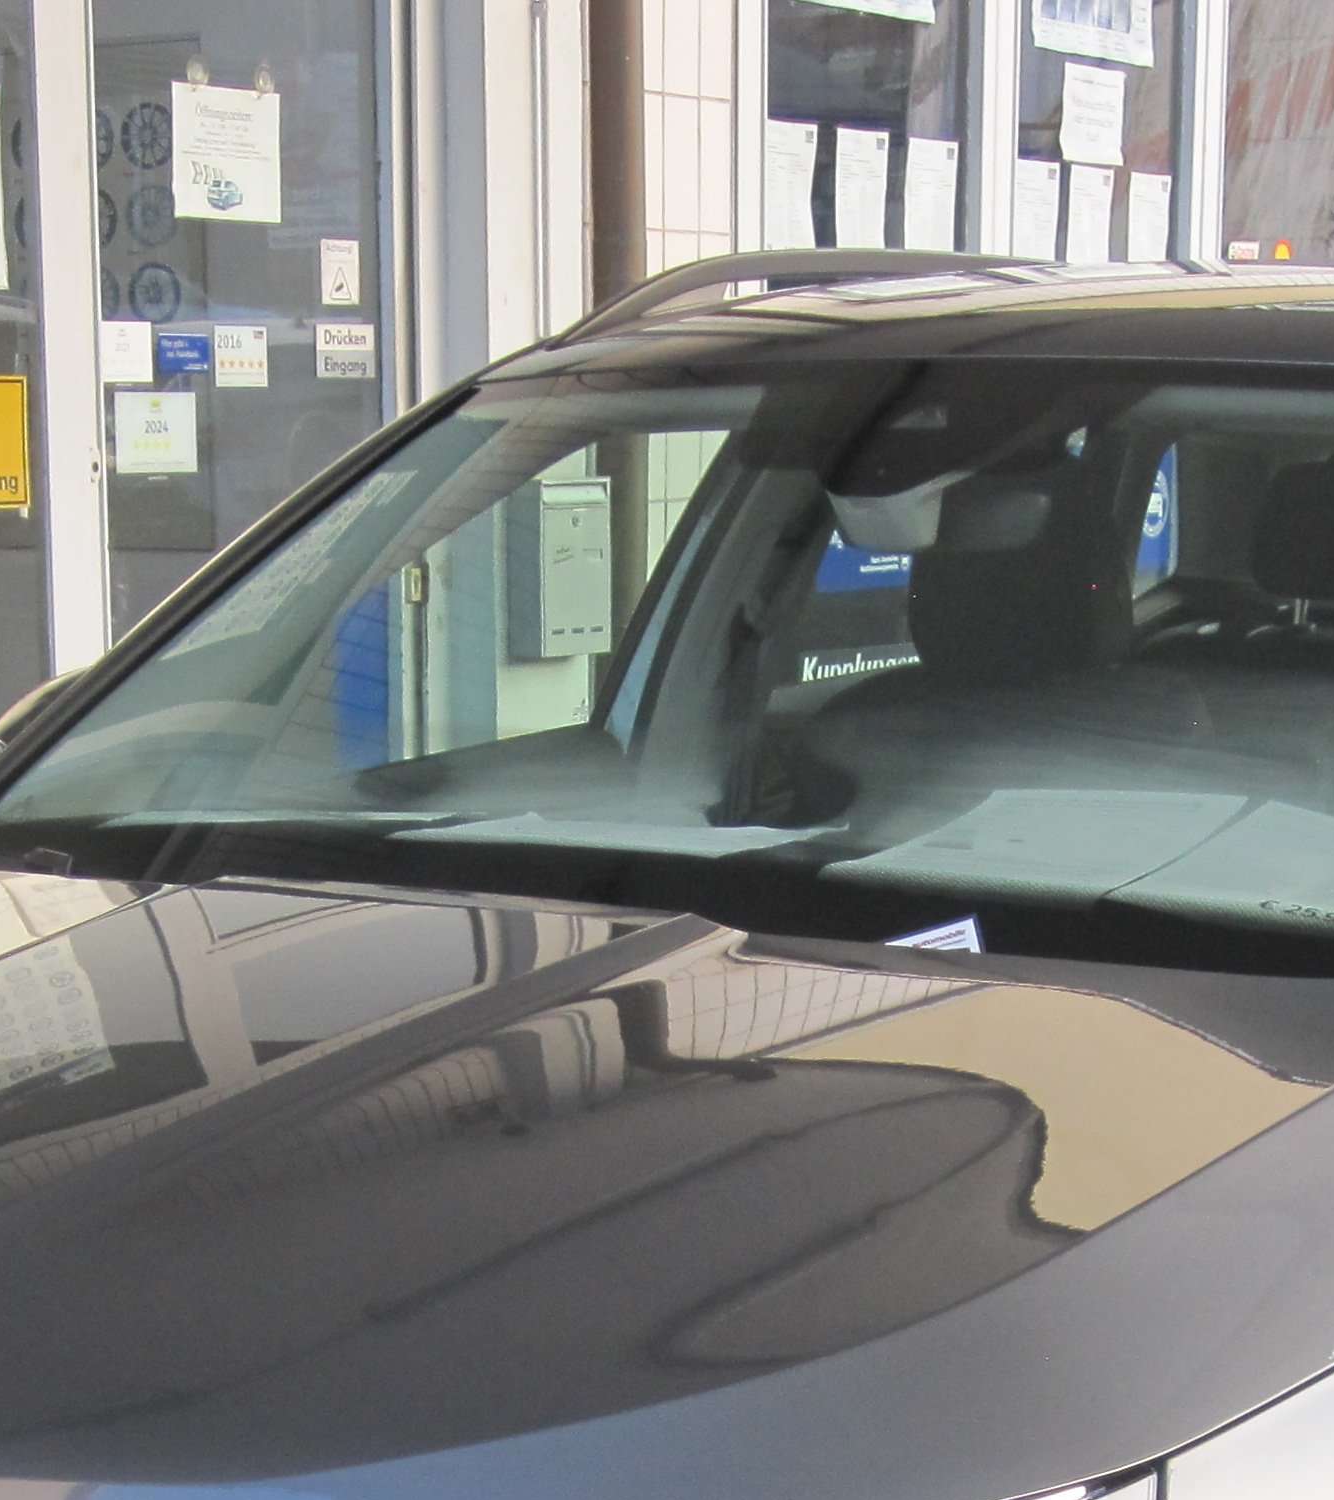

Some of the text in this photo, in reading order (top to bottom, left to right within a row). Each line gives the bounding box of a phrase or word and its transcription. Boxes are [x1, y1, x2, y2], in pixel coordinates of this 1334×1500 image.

[216, 334, 242, 349] 2016
[324, 329, 367, 345] Drücken
[324, 356, 367, 376] Eingang
[144, 420, 169, 434] 2024
